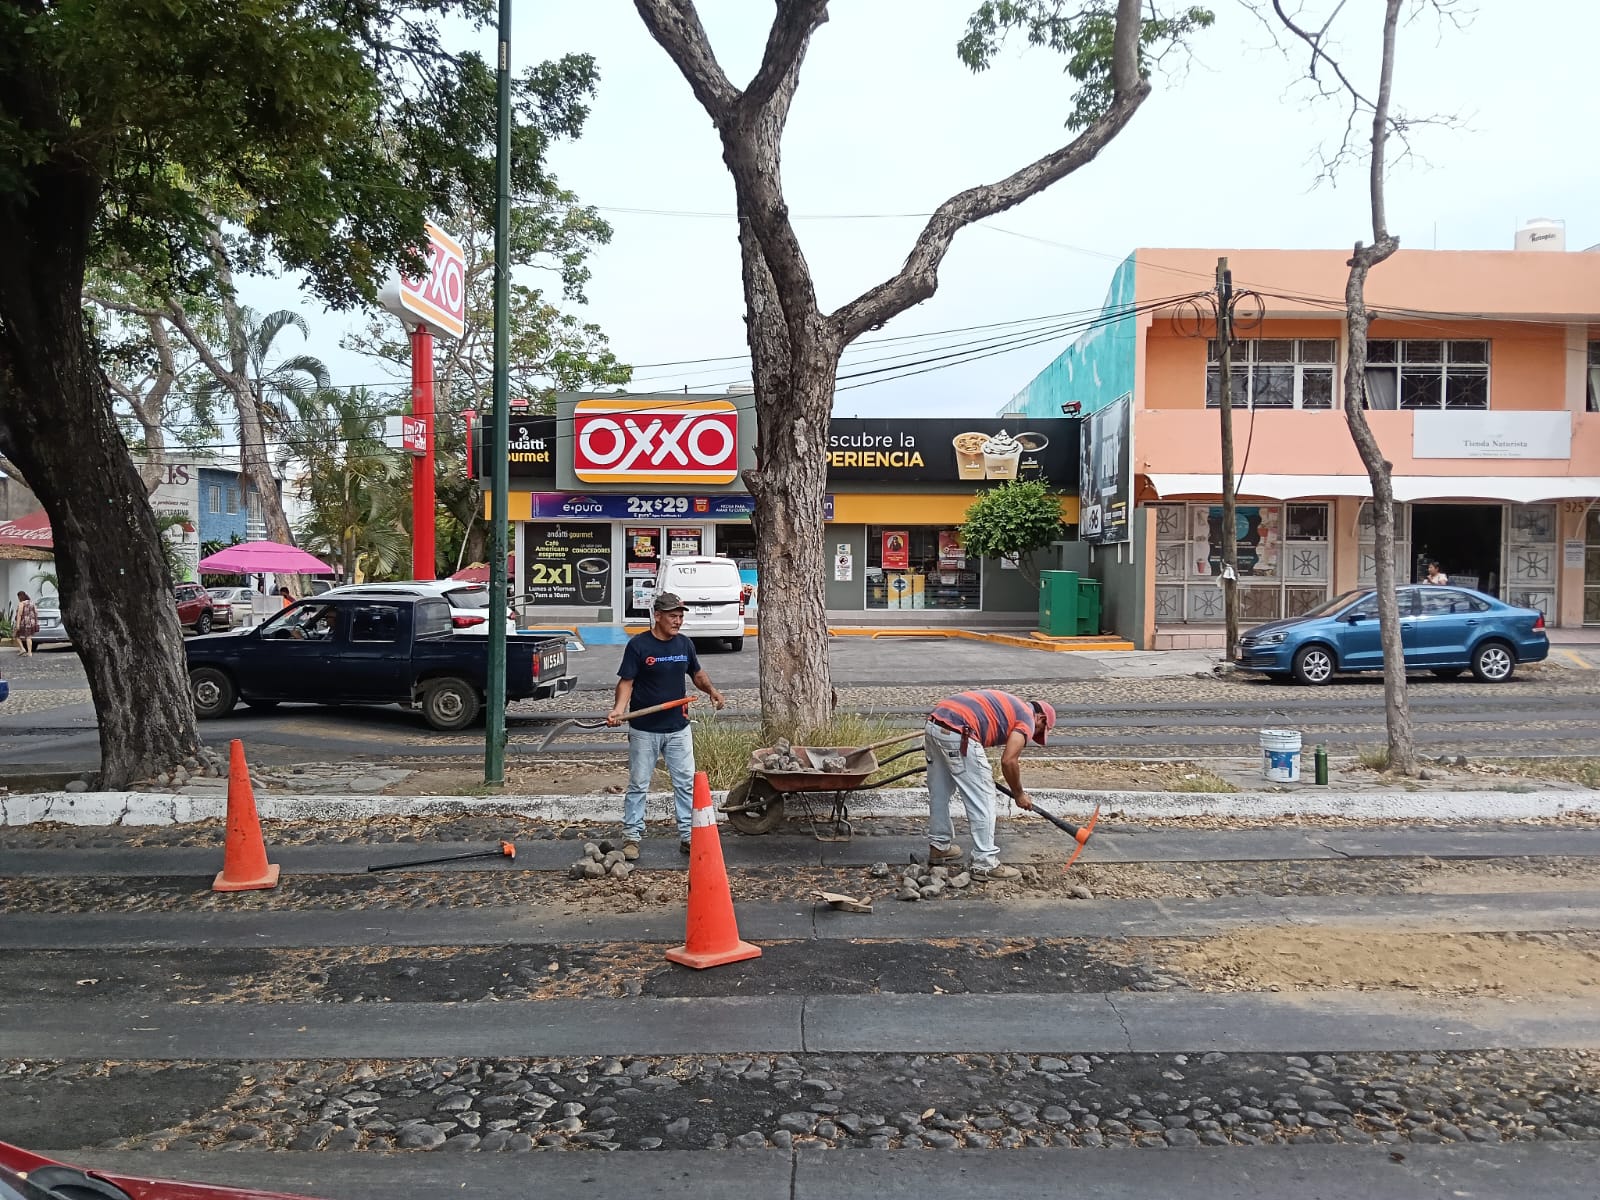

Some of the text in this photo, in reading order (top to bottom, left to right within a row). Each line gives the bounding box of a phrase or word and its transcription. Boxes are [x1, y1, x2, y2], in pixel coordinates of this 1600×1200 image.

[408, 247, 463, 313] XXO
[507, 437, 544, 450] ndatti
[579, 413, 734, 471] OXXO
[827, 431, 915, 448] scubre la
[507, 451, 549, 462] ourmet
[826, 451, 925, 467] PERIENCIA
[569, 531, 594, 540] gourmet
[531, 563, 572, 584] 2x1
[543, 652, 565, 670] NISSAN
